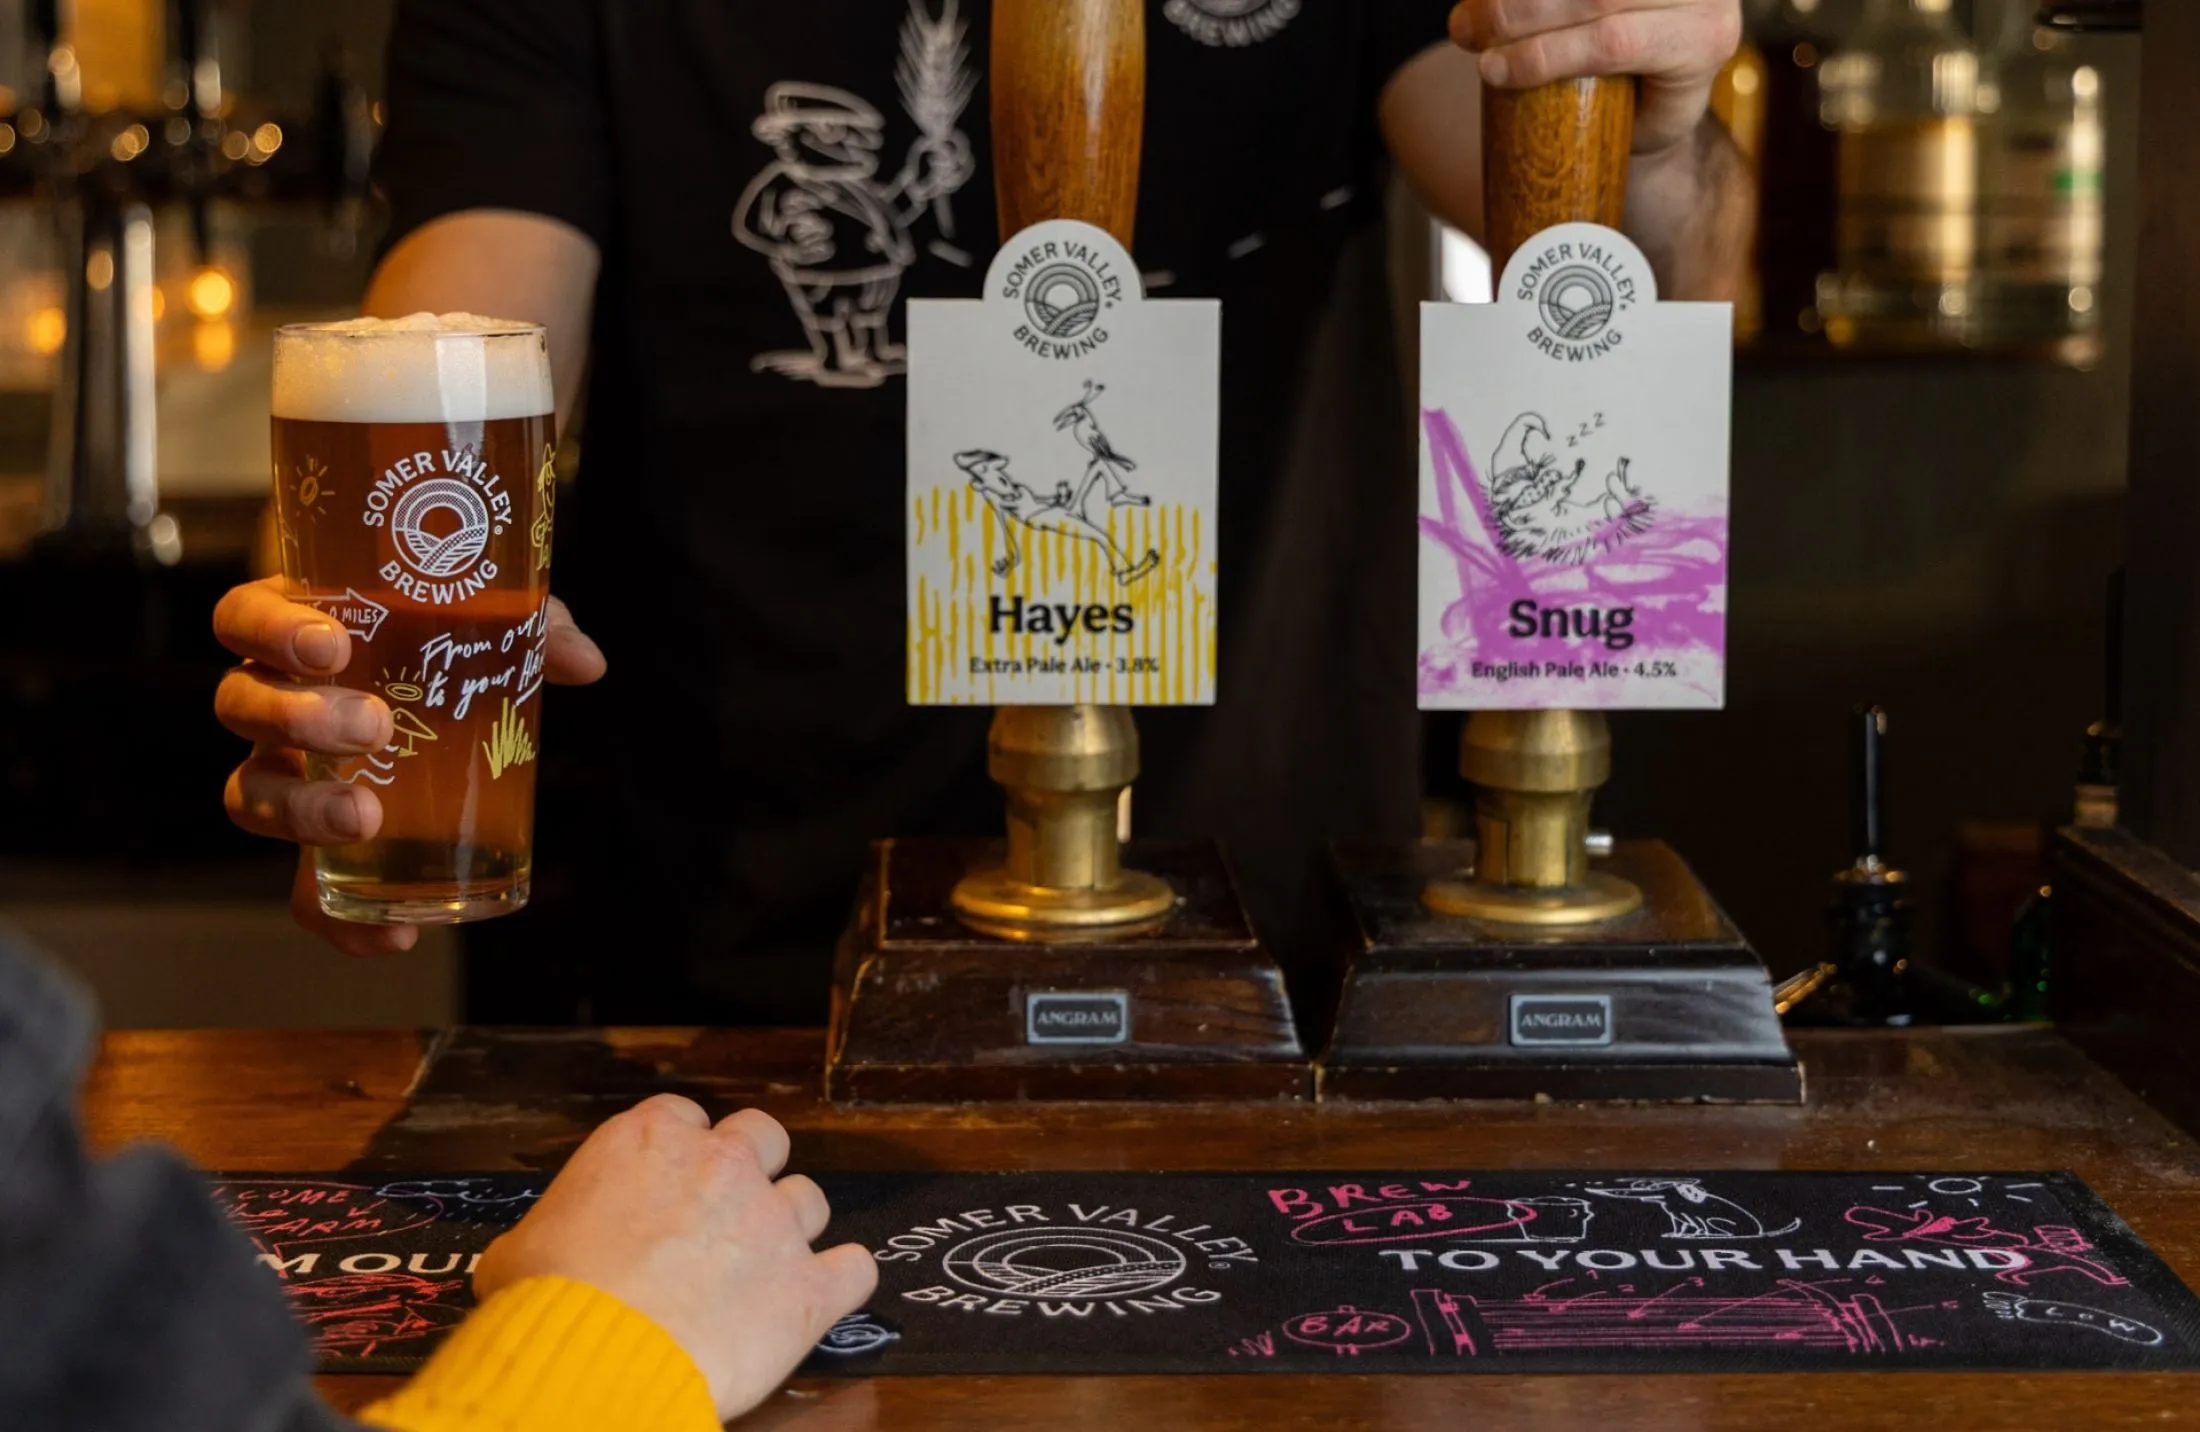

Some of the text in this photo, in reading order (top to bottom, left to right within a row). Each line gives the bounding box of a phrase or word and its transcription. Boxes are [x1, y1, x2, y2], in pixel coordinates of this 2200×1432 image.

[1003, 241, 1058, 300] SOMER
[1517, 243, 1573, 301] SOMER
[1012, 324, 1110, 360] BREWING
[1526, 326, 1622, 363] BREWING
[363, 451, 437, 528] SOMER
[378, 558, 499, 606] BREWING
[342, 606, 379, 625] MILES
[988, 594, 1135, 646] Hayes
[1508, 599, 1635, 651] Snug
[419, 632, 493, 683] From
[500, 610, 538, 654] our
[969, 656, 1160, 675] Extra Pale Ale 3.8%
[1471, 661, 1678, 682] English Pale Ale 4.5%
[453, 664, 517, 721] your
[1036, 1011, 1119, 1025] ANGRAM
[1520, 1013, 1602, 1028] ANGRAM
[1268, 1178, 1471, 1220] BREW
[874, 1203, 1260, 1264] SOMER VALLEY
[1343, 1203, 1454, 1233] LAB
[1378, 1248, 2033, 1271] TO YOUR HAND
[901, 1285, 1223, 1317] BREWING
[1299, 1315, 1391, 1338] BAR
